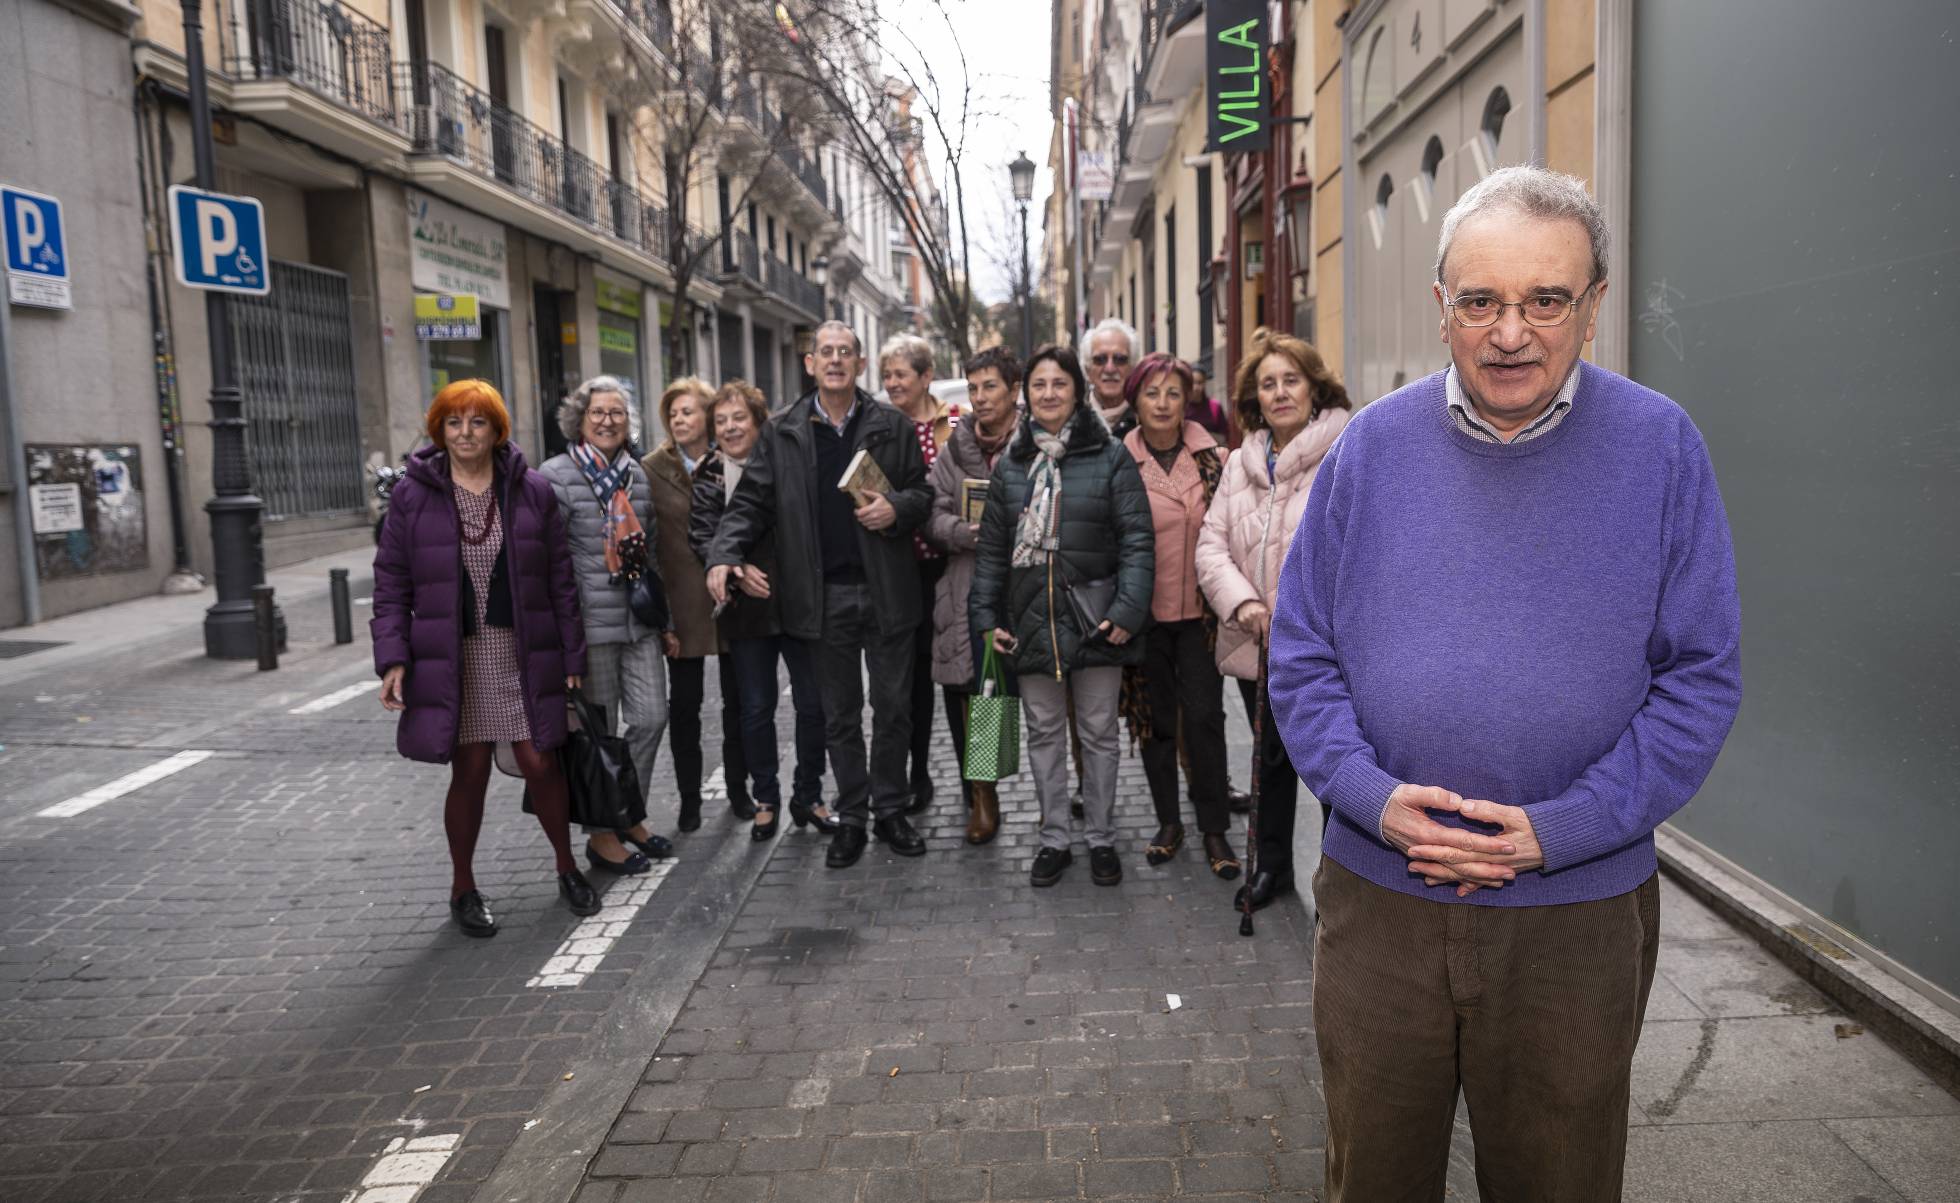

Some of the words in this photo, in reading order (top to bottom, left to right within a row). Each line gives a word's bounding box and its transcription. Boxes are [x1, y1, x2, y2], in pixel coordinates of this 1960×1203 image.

[1411, 10, 1422, 54] 4
[1217, 18, 1260, 144] VILLA
[14, 197, 45, 266] P
[196, 198, 238, 277] P
